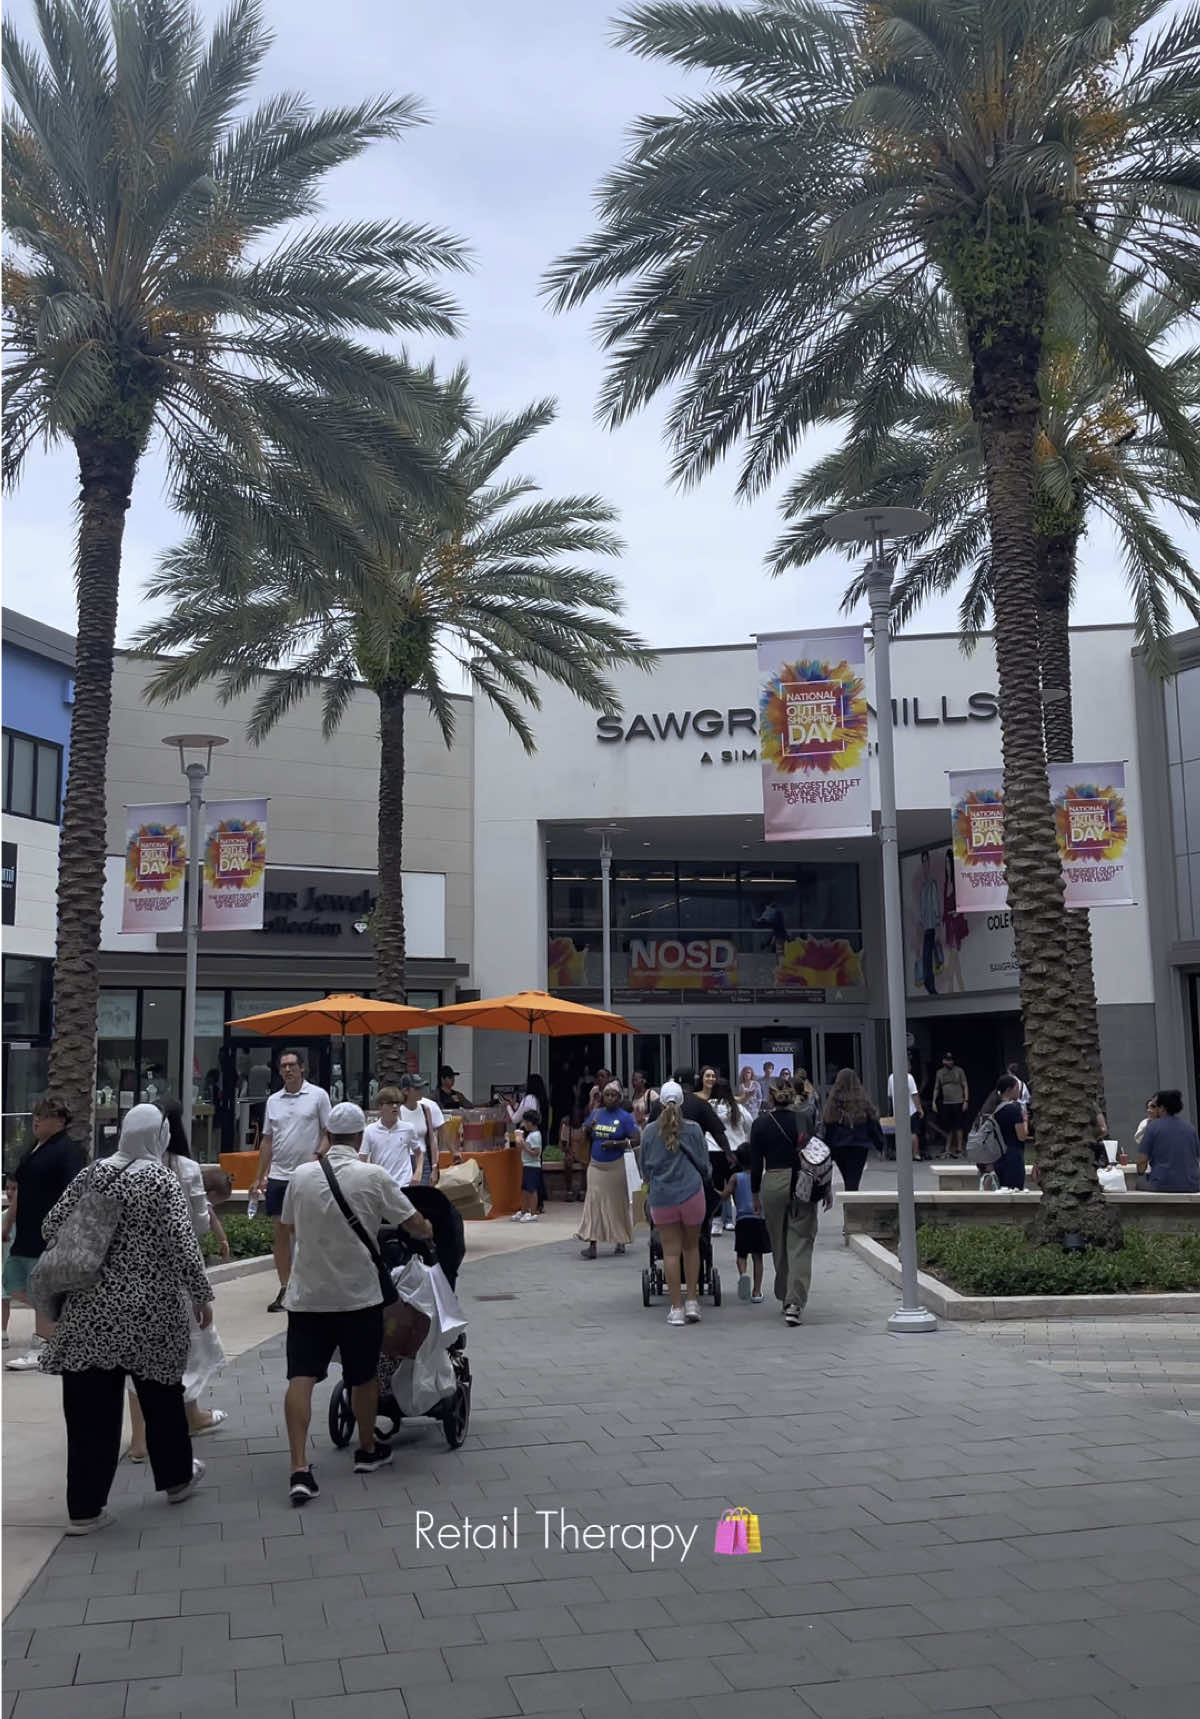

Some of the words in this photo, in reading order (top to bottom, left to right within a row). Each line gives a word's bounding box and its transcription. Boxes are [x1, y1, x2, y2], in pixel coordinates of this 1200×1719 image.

[786, 691, 835, 701] NATIONAL
[786, 703, 835, 717] OUTLET
[597, 708, 758, 741] SAWGR
[787, 714, 837, 724] SHOPPING
[789, 722, 836, 746] DAY
[700, 752, 712, 762] A
[722, 750, 757, 762] SIM
[771, 783, 788, 791] THE
[790, 781, 825, 790] BIGGEST
[827, 779, 861, 788] OUTLET
[801, 796, 816, 804] THE
[970, 819, 1003, 828] OUTLE
[1072, 825, 1105, 842] DAY
[140, 859, 169, 875] DAY
[219, 857, 248, 872] DAY
[987, 913, 1009, 931] COLE
[631, 939, 736, 969] NOSD
